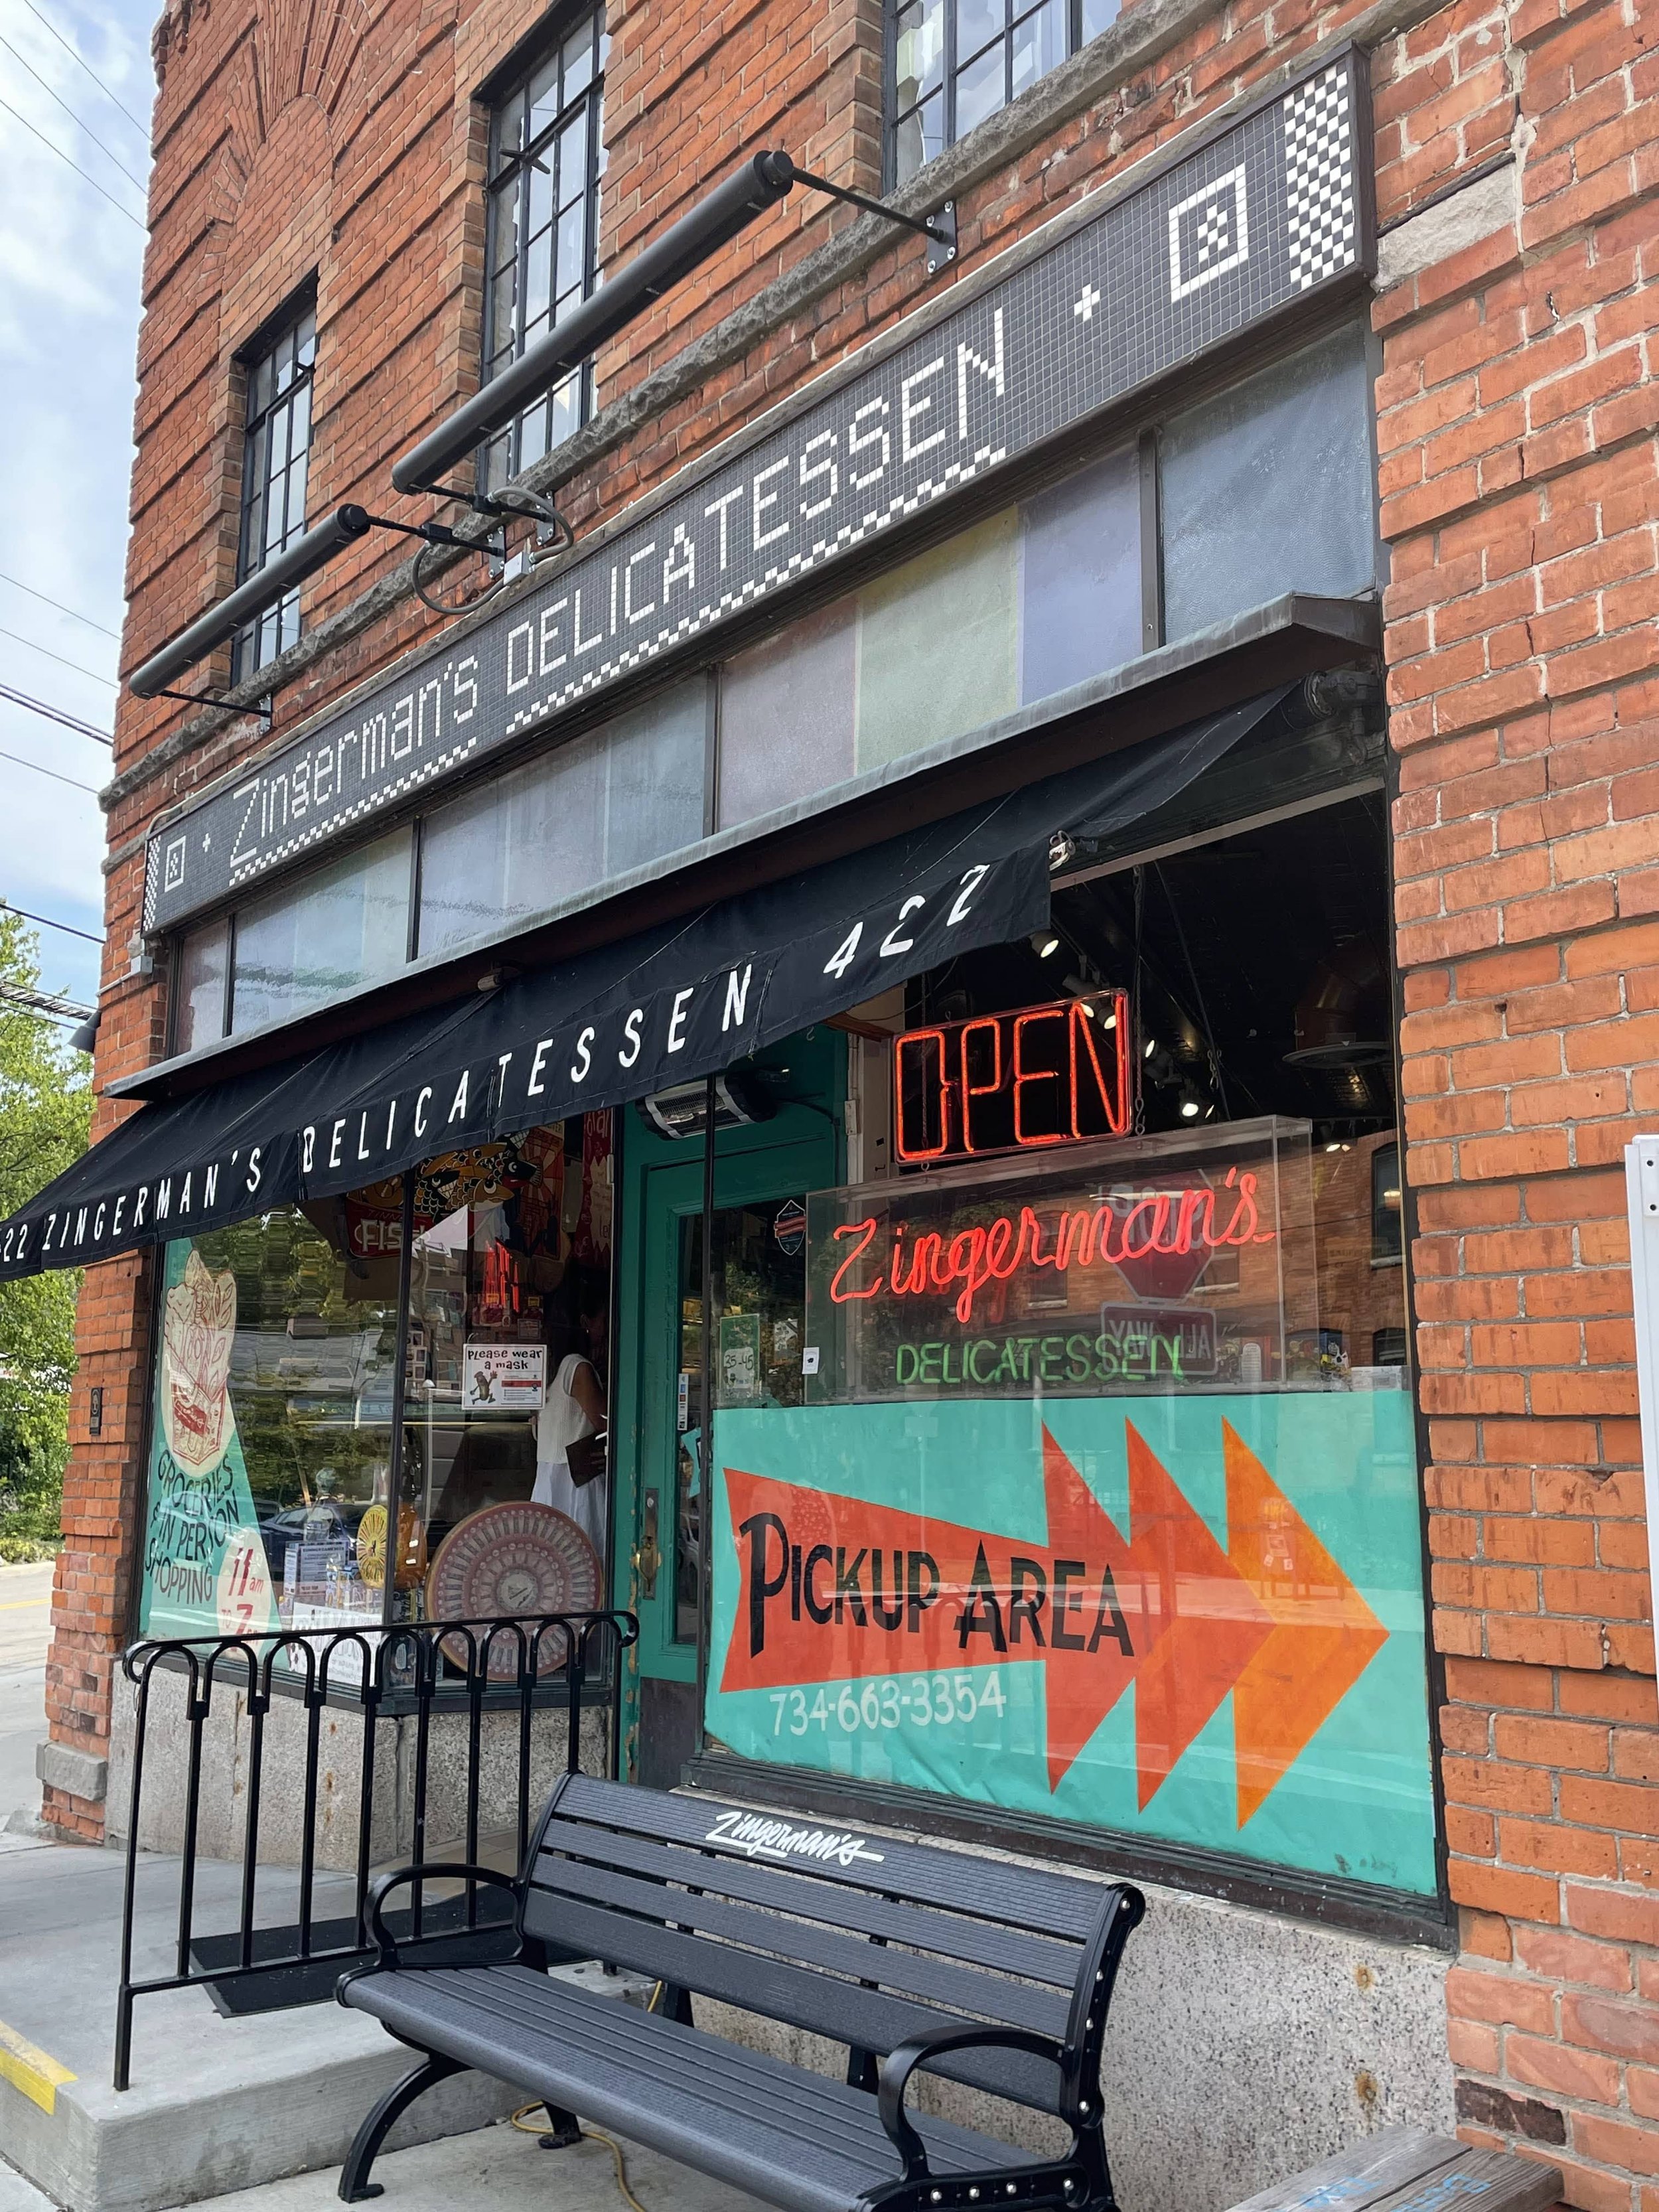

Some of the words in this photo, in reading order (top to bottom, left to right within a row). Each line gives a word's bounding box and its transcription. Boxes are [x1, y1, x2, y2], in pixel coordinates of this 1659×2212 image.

[230, 655, 478, 867] Zingerman's
[507, 308, 1005, 695] DELICATESSEN
[0, 1224, 27, 1262] 22
[42, 1147, 261, 1250] ZINGERMAN'S
[303, 964, 752, 1173] DELICATESSEN
[824, 864, 991, 980] 422
[896, 994, 1127, 1160] OPEN
[830, 1166, 1275, 1323] Zingerman's
[484, 1361, 491, 1370] a
[496, 1360, 529, 1370] mask
[512, 1350, 543, 1359] wear
[896, 1334, 1185, 1384] DELICATESSEN
[158, 1449, 233, 1516] GROCERIES
[159, 1512, 177, 1550] IN
[177, 1489, 240, 1561] PERSON
[145, 1537, 213, 1605] SHOPPING
[739, 1512, 939, 1659] PICKUP
[954, 1540, 1135, 1657] AREA
[768, 1671, 1007, 1737] 734-663-3354
